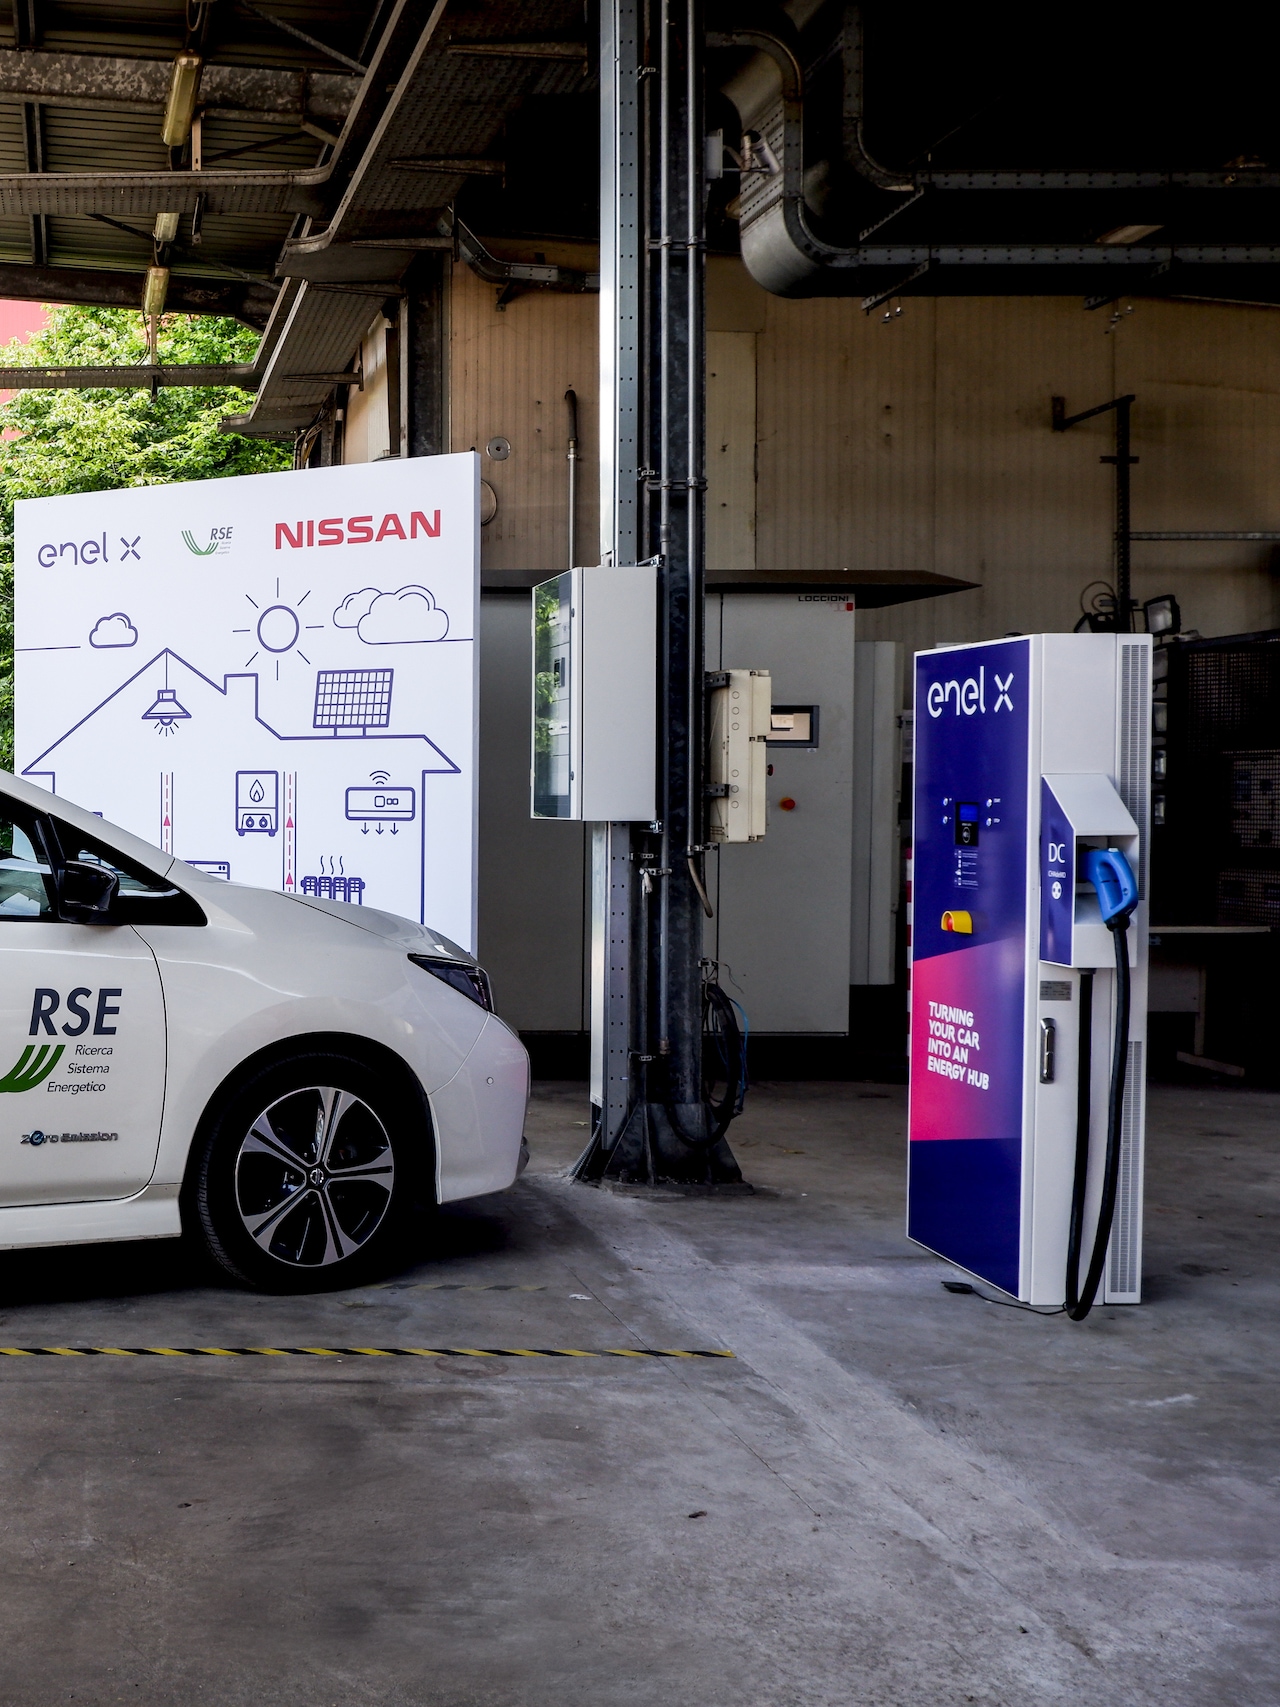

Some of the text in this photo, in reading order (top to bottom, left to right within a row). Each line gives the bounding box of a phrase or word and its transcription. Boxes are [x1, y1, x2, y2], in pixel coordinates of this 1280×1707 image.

[210, 526, 234, 541] RSE
[275, 509, 442, 550] NISSAN
[37, 531, 109, 568] enel
[927, 665, 986, 719] enel
[1048, 843, 1066, 863] DC
[28, 987, 123, 1037] RSE
[928, 1001, 974, 1027] TURNING
[928, 1019, 980, 1051] YOUR CAR
[74, 1044, 113, 1056] Ricerca
[928, 1037, 969, 1064] INTO AN
[66, 1063, 110, 1075] Sistema
[927, 1055, 990, 1091] ENERGY HUB
[46, 1081, 106, 1095] Energetico
